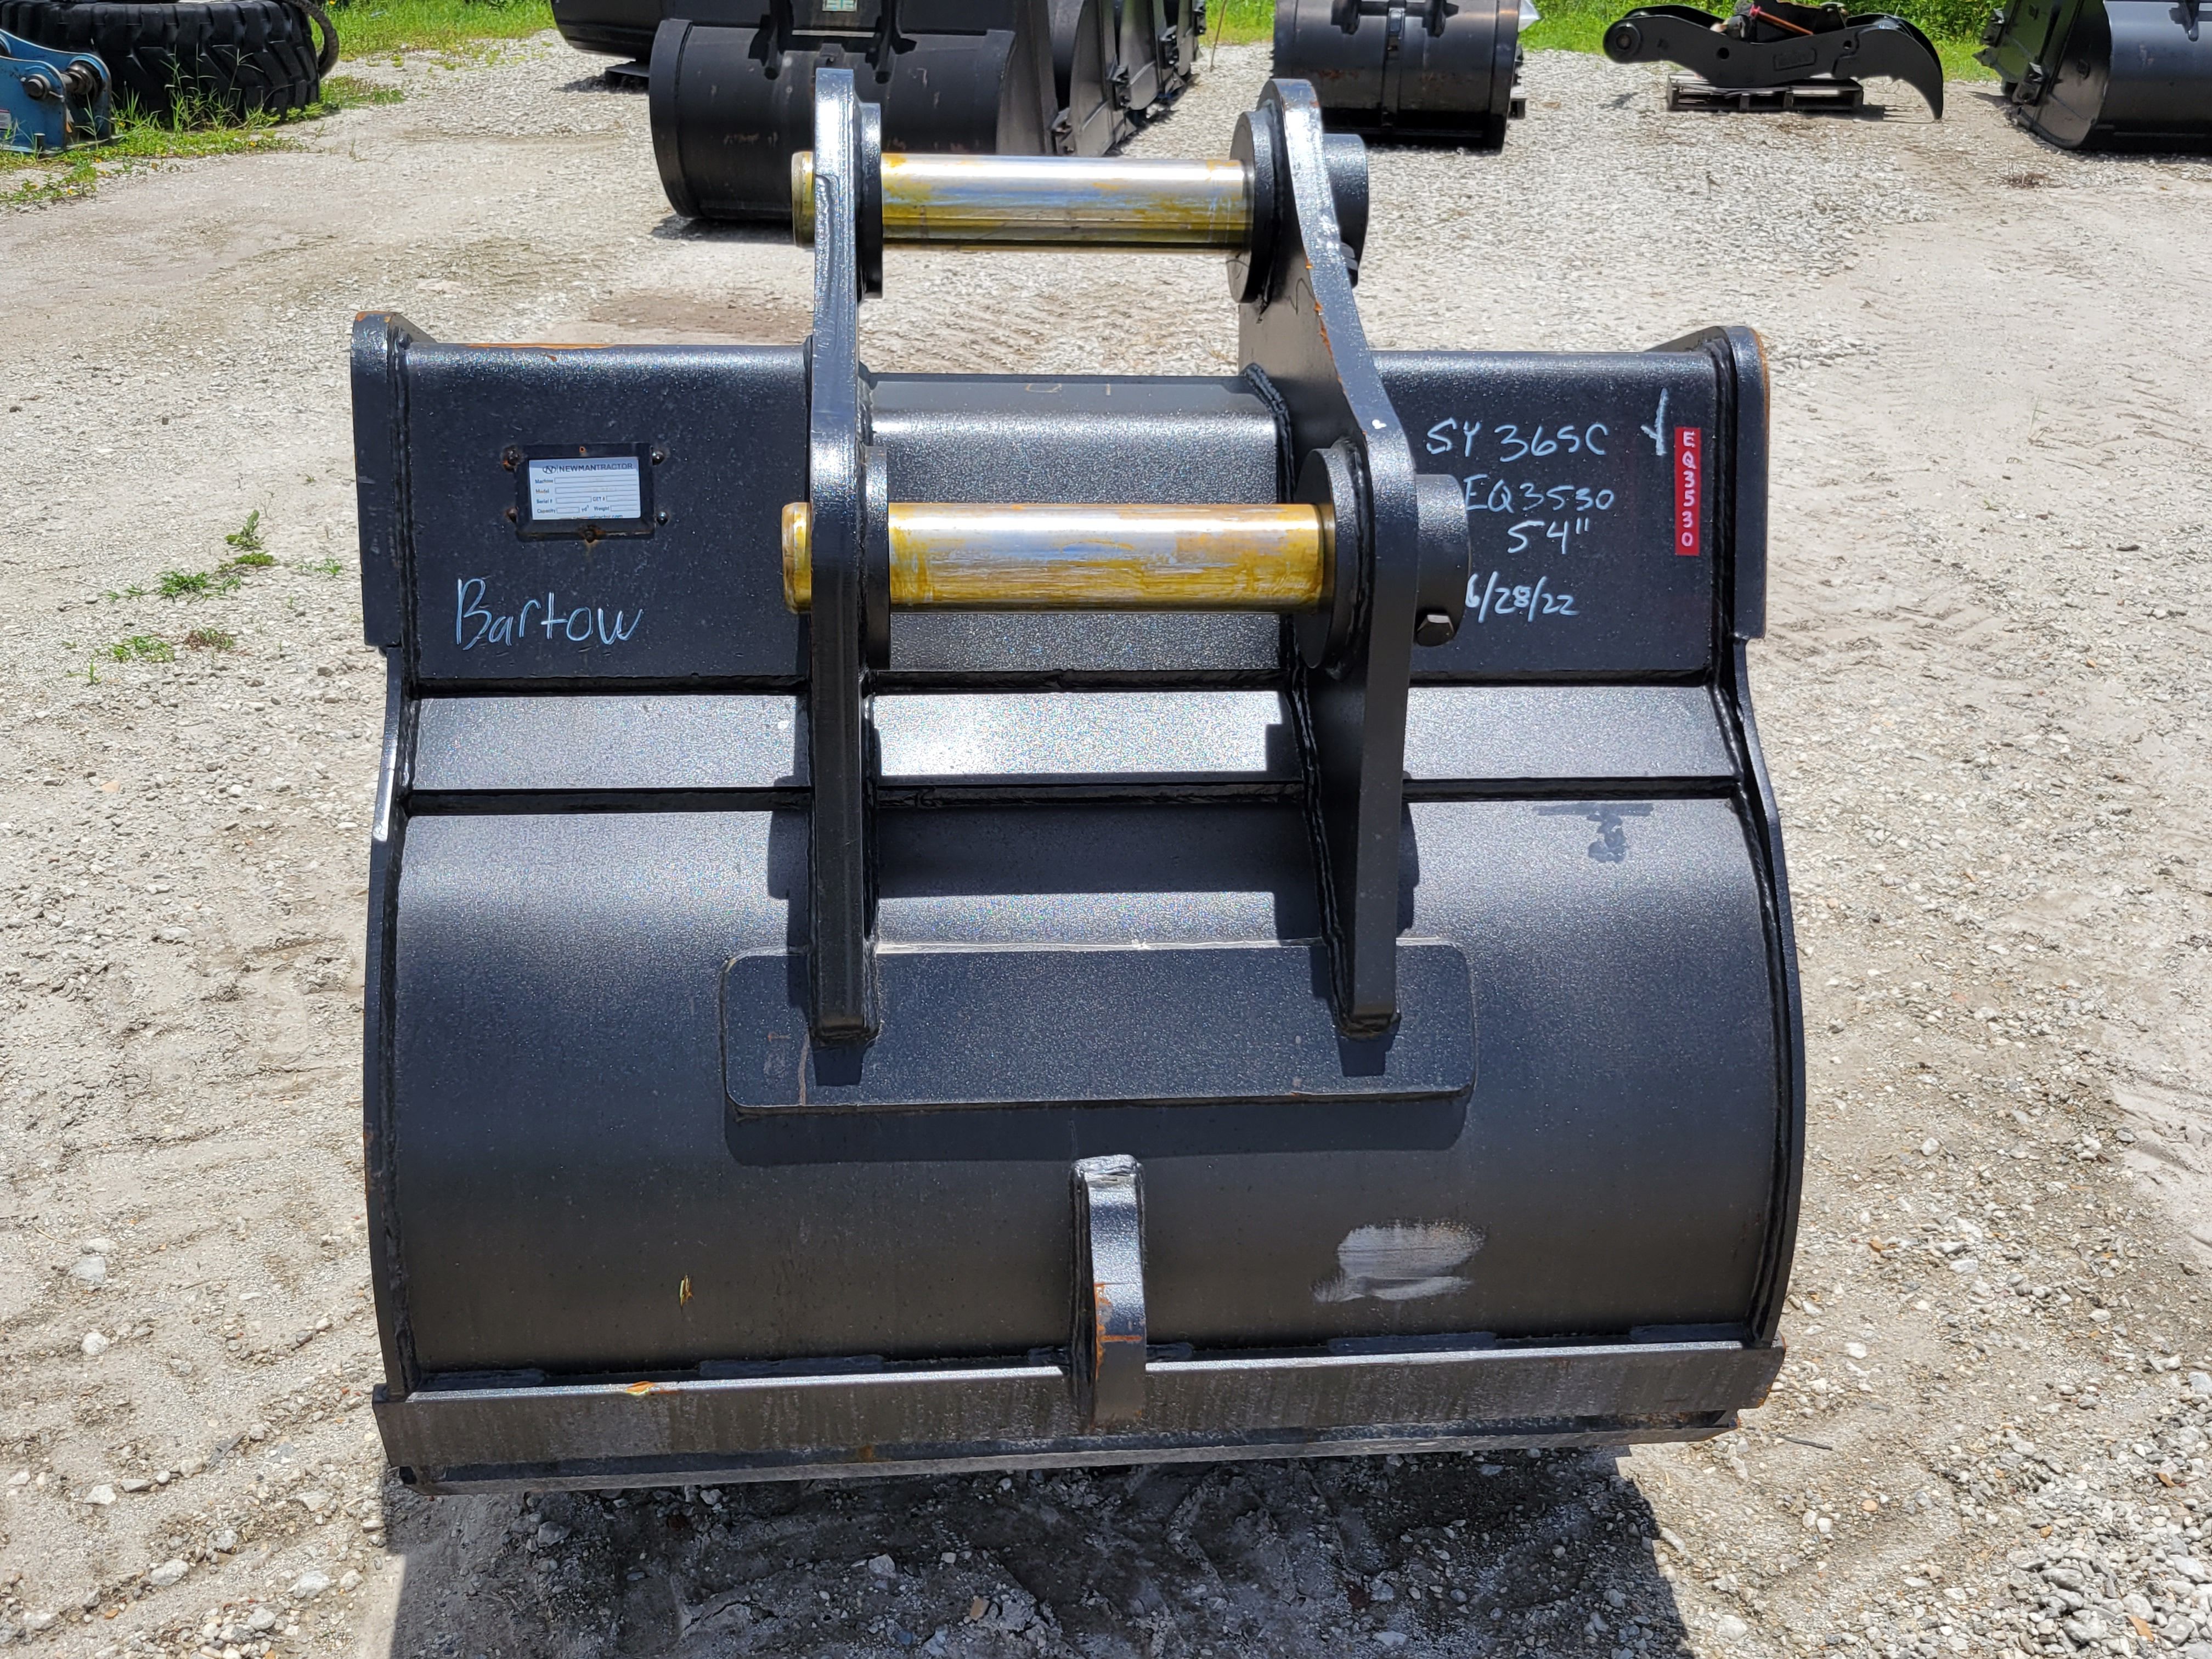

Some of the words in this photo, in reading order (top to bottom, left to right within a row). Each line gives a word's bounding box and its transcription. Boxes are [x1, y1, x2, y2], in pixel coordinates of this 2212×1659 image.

[559, 463, 633, 472] NEWMANTRACTOR
[1463, 473, 1615, 513] EQ3530
[455, 578, 644, 651] Bartow
[1465, 571, 1580, 623] 6/28/22
